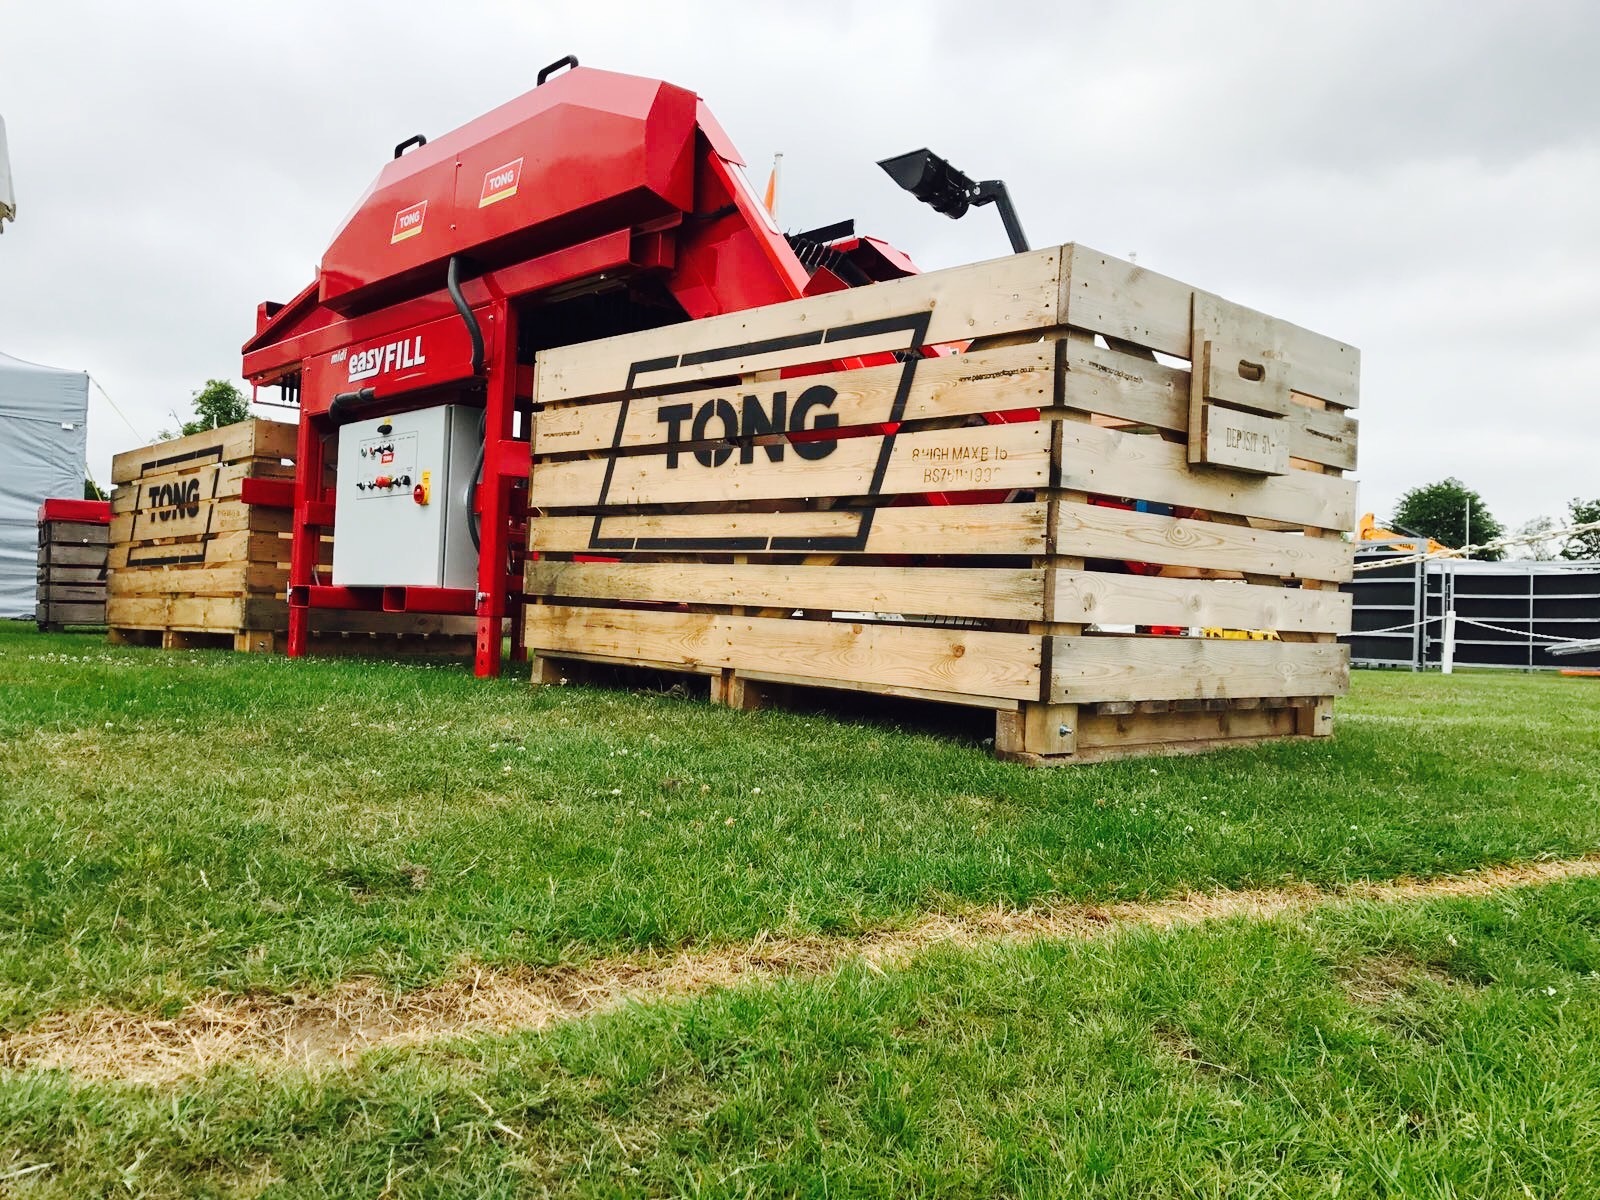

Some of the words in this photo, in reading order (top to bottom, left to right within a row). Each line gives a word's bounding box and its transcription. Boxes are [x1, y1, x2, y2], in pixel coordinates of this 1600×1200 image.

[489, 170, 514, 190] TONG
[399, 211, 420, 228] TONG
[330, 348, 348, 364] midi
[658, 385, 839, 469] TONG
[148, 478, 200, 524] TONG
